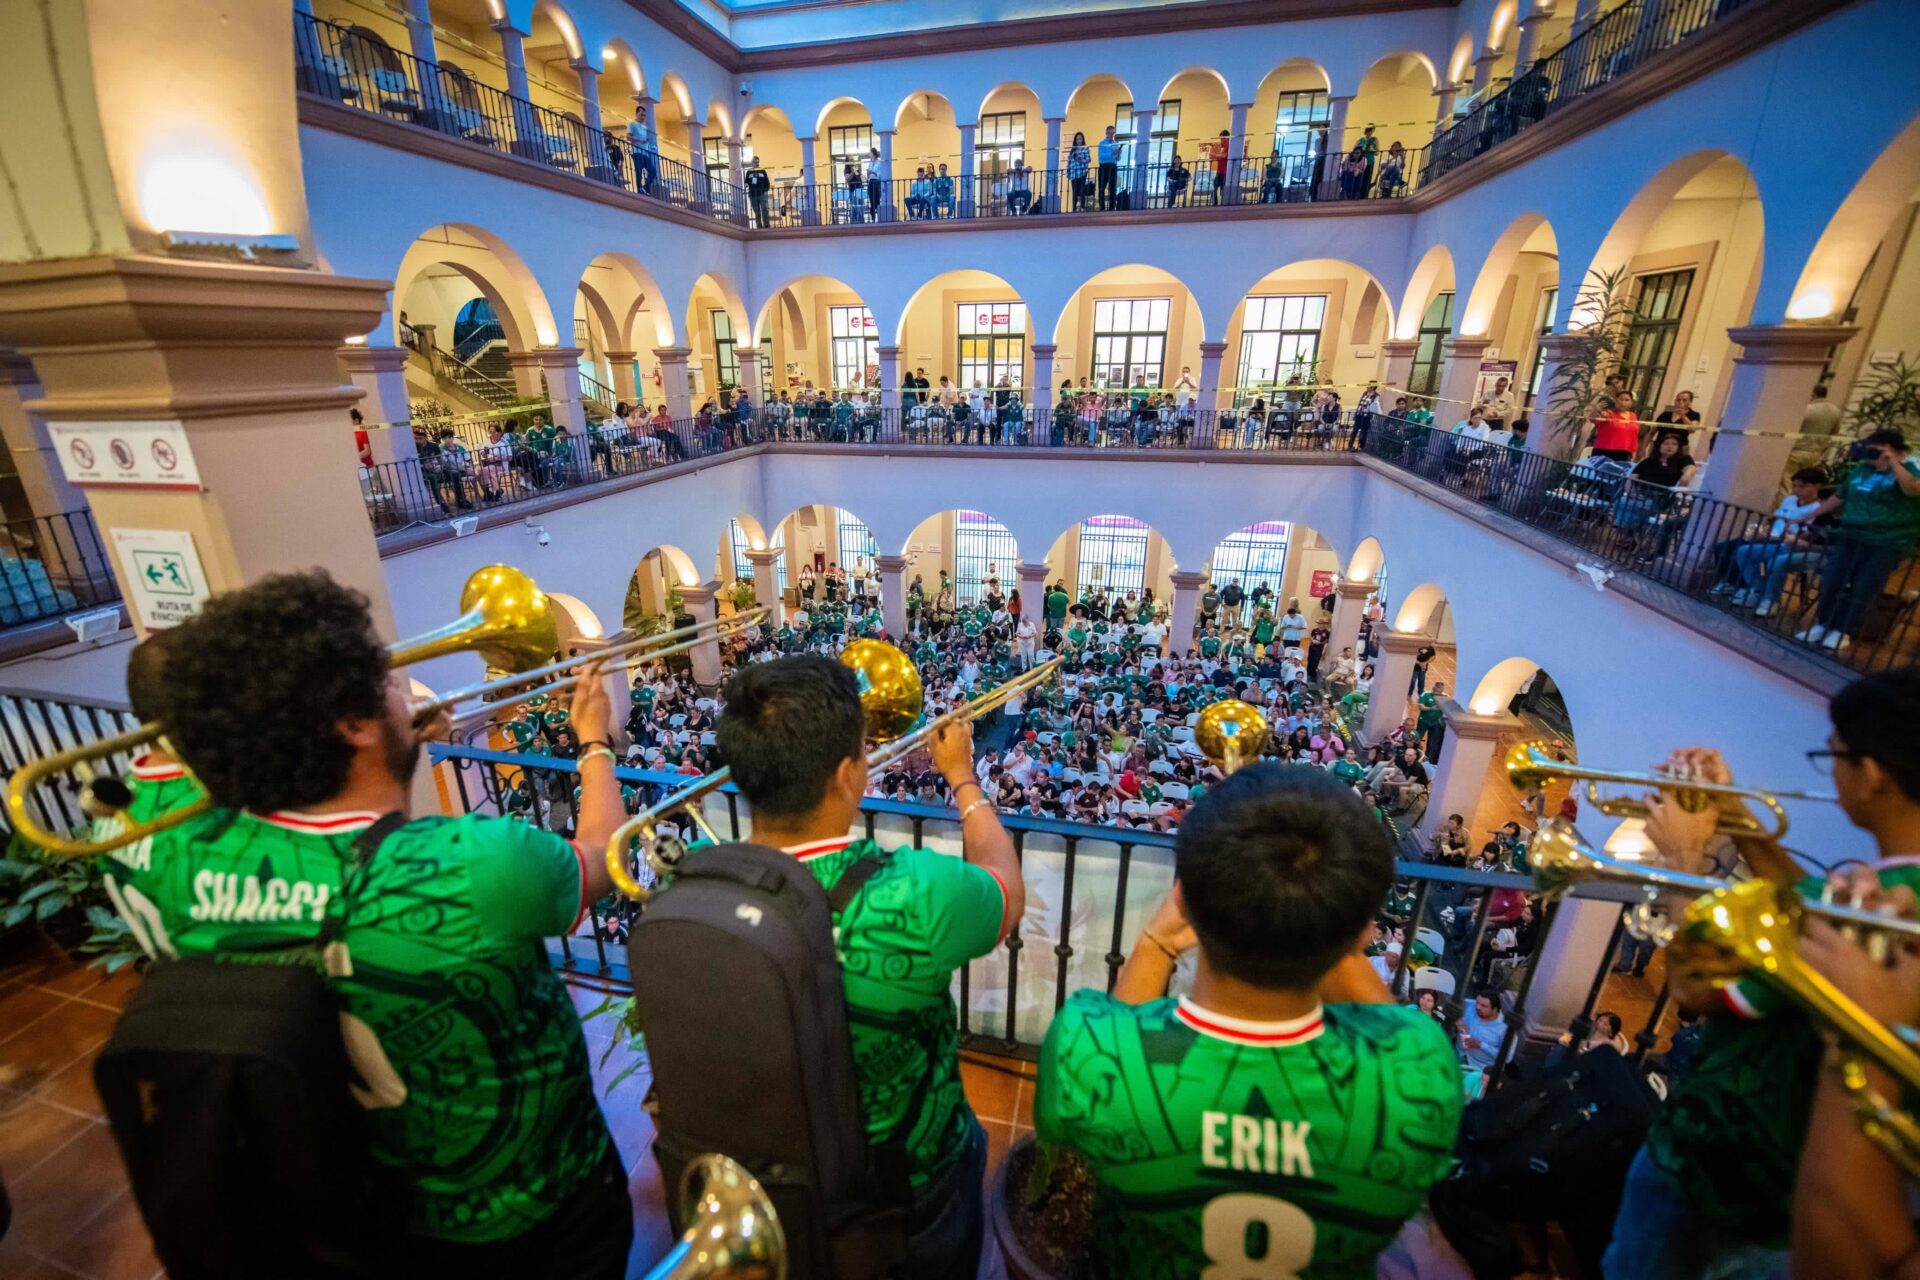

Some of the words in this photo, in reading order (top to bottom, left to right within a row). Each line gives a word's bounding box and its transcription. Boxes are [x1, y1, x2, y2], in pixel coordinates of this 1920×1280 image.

[156, 601, 180, 611] RUTA
[190, 868, 330, 923] SHAGGY
[1202, 1110, 1314, 1178] ERIK
[1200, 1193, 1316, 1280] 8
